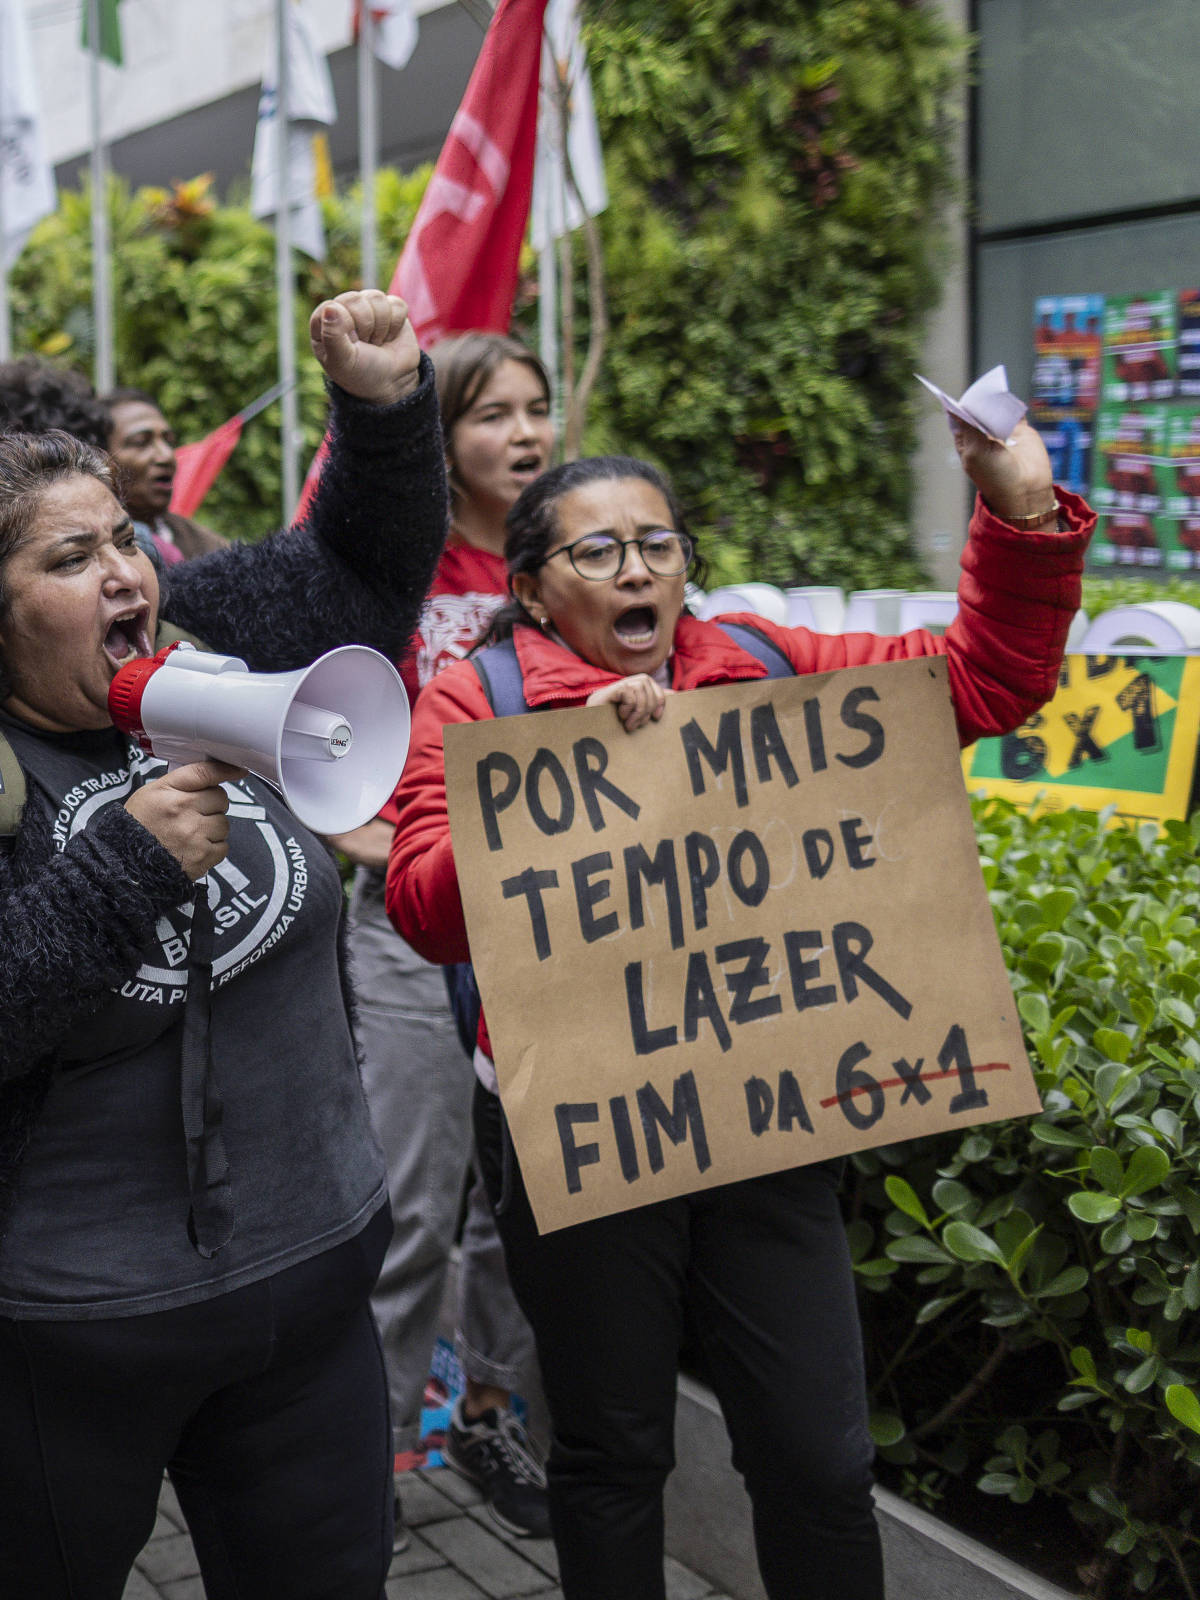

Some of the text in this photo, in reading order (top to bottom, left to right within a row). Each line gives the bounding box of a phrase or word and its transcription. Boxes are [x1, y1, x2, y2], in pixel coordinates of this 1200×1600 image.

[477, 687, 885, 851] POR MAIS
[218, 915, 295, 987] REFORMA
[287, 837, 308, 912] URBANA
[501, 818, 877, 960] TEMPO DE
[625, 921, 912, 1055] LAZER
[555, 1070, 711, 1194] FIM
[745, 1070, 814, 1135] DA
